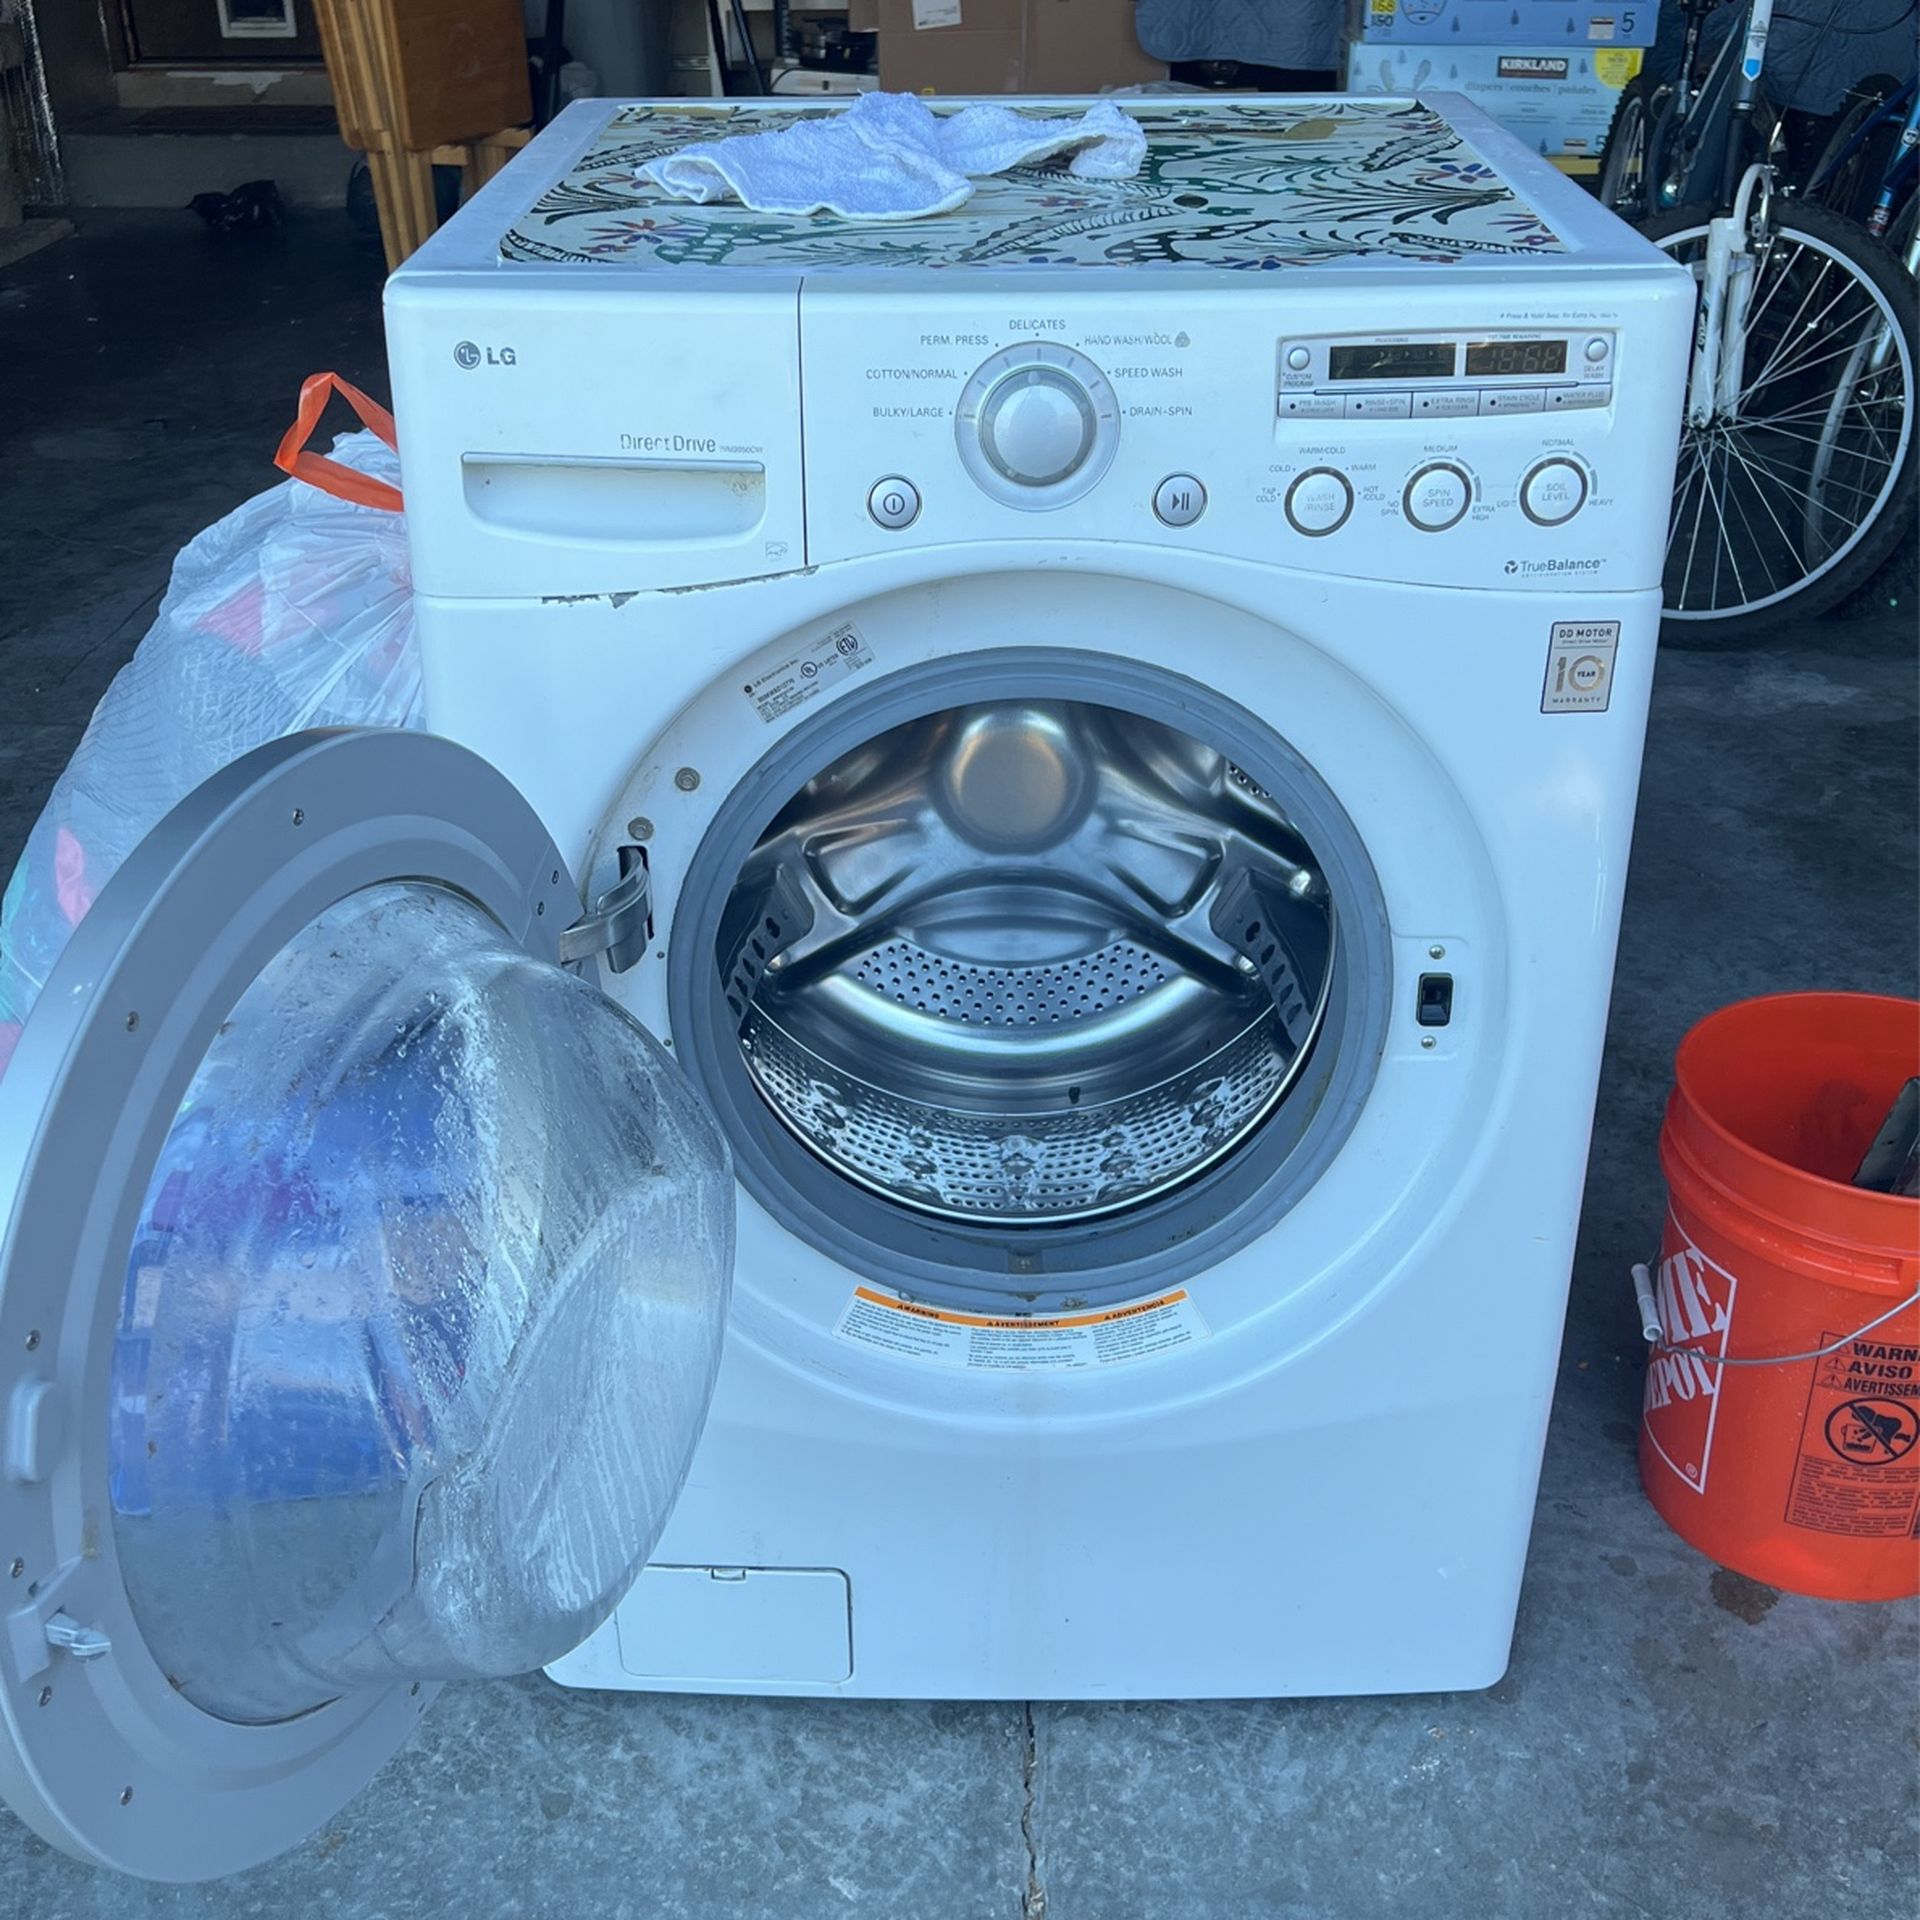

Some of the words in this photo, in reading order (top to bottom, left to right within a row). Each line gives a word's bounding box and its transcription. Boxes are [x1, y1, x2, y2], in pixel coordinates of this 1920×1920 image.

[1621, 12, 1636, 33] 5
[1500, 58, 1567, 72] KIRKLAND
[1009, 319, 1066, 330] DELICATES
[920, 335, 952, 346] PERM.
[955, 335, 989, 346] PRESS
[1084, 335, 1112, 346] HAND
[486, 346, 516, 366] LG
[866, 369, 958, 380] COTTON/NORMAL
[1114, 367, 1149, 378] SPEED
[1151, 367, 1183, 378] WASH
[873, 407, 944, 418] BULKY/LARGE
[620, 433, 670, 451] Direct
[673, 435, 716, 453] Drive
[1424, 445, 1458, 453] MEDIUM
[1269, 465, 1291, 473] COLD
[1546, 483, 1566, 491] SOIL
[1428, 489, 1450, 497] SPIN
[1542, 492, 1570, 501] LEVEL
[1256, 495, 1277, 503] COLD
[1423, 497, 1454, 508] SPEED
[1381, 508, 1399, 516] SPIN
[1472, 505, 1496, 513] EXTRA
[1559, 629, 1574, 638] DD
[1576, 628, 1612, 638] MOTOR
[1555, 655, 1605, 692] 10
[1577, 670, 1596, 678] YEAR
[904, 1305, 940, 1319] WARNING
[1112, 1300, 1165, 1319] ADVERTENCIA
[995, 1320, 1060, 1328] AVERTISSEMENT
[1848, 1361, 1912, 1380] AVISO
